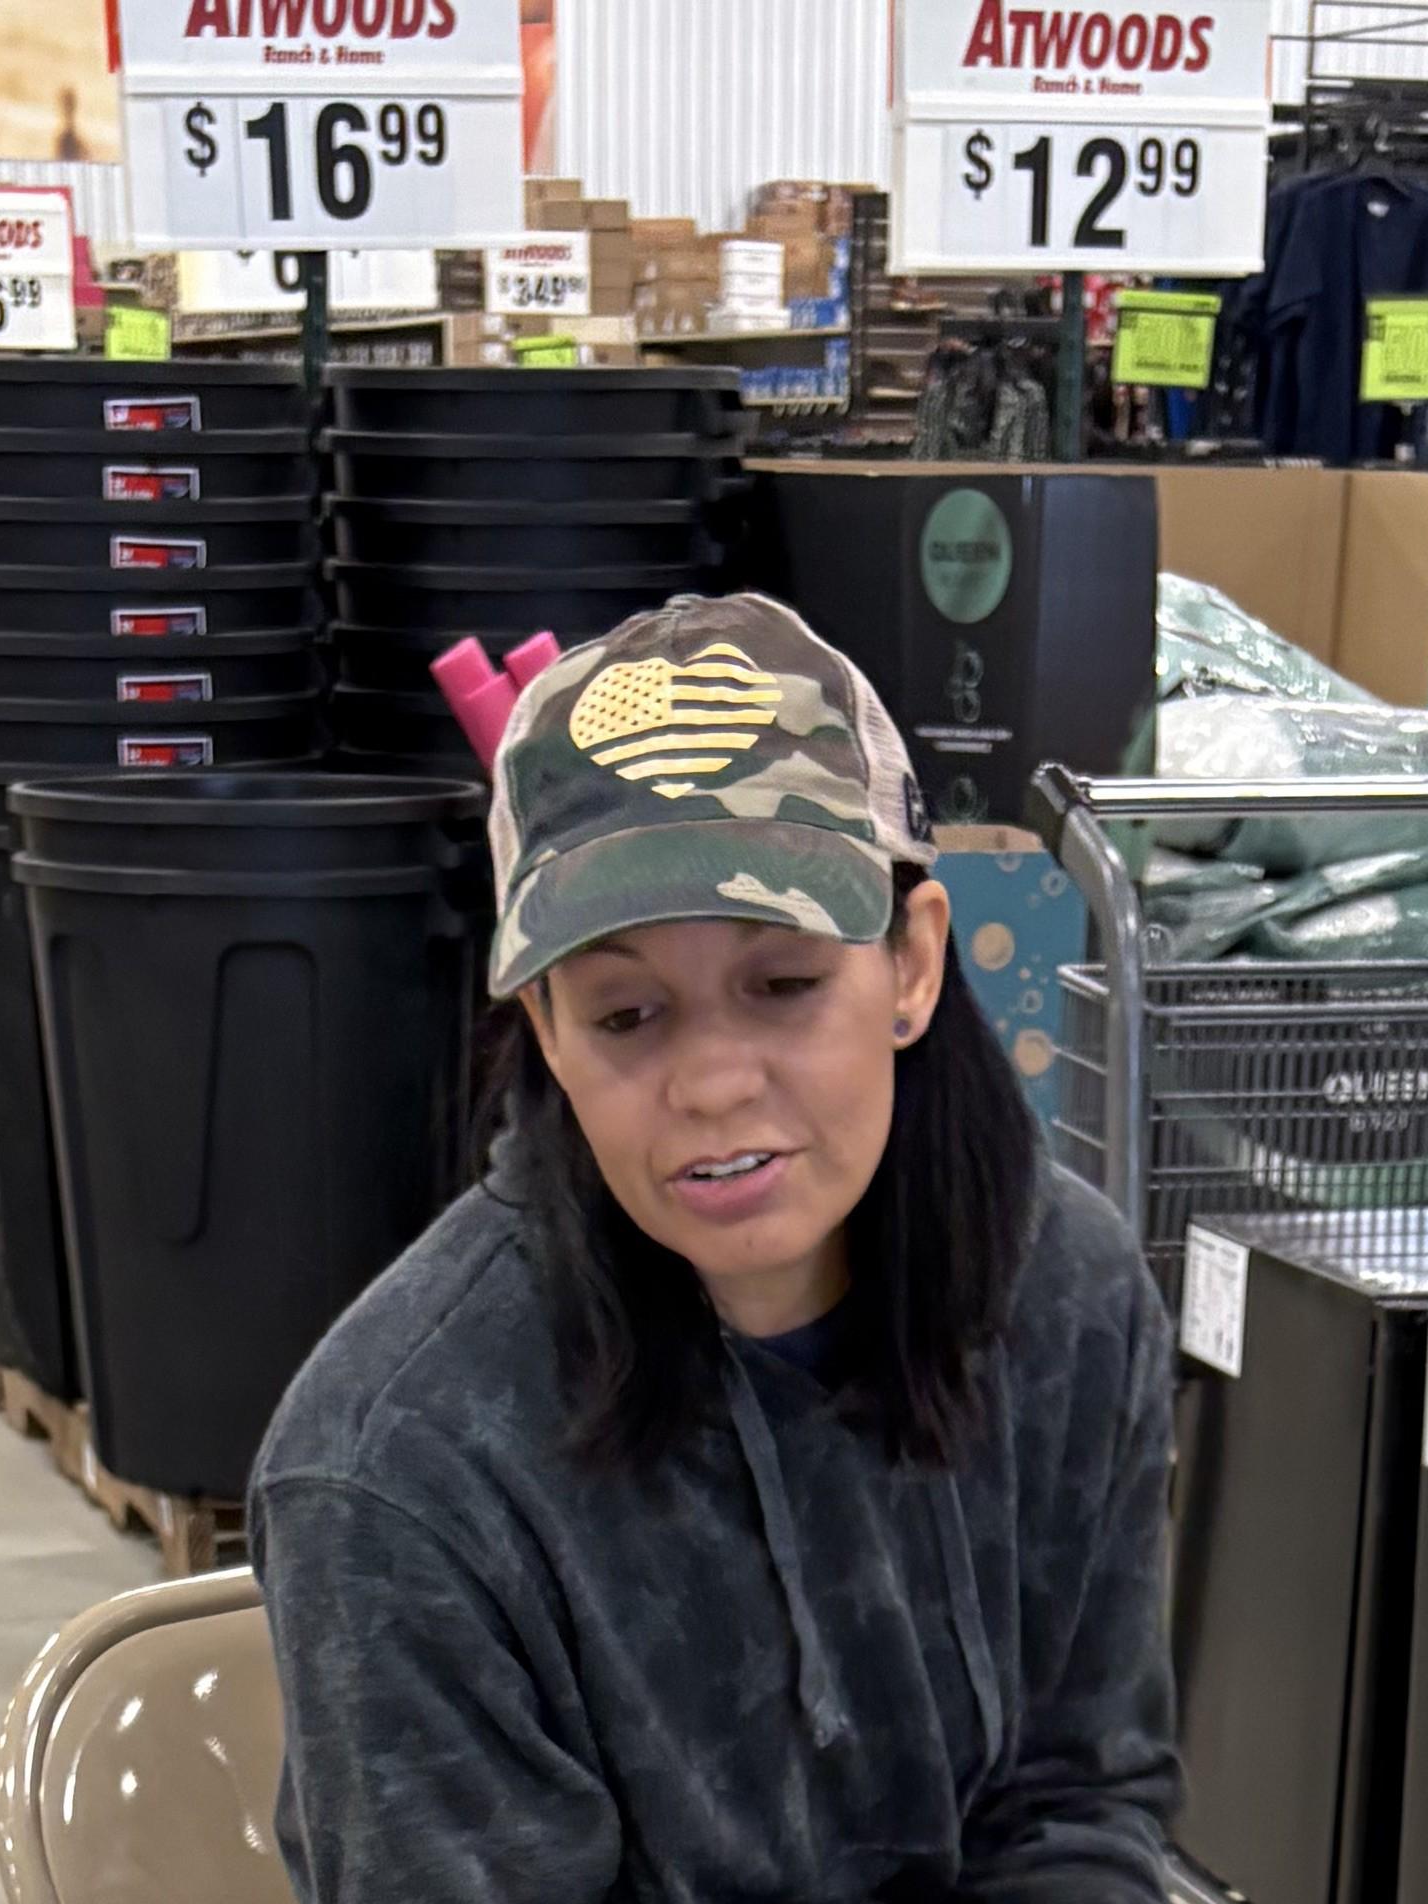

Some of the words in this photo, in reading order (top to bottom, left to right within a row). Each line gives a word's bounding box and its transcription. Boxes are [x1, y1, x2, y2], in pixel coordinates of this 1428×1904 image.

[264, 45, 315, 64] Ranch
[319, 46, 332, 64] &
[336, 46, 384, 64] Home
[962, 0, 1215, 73] ATWOODS
